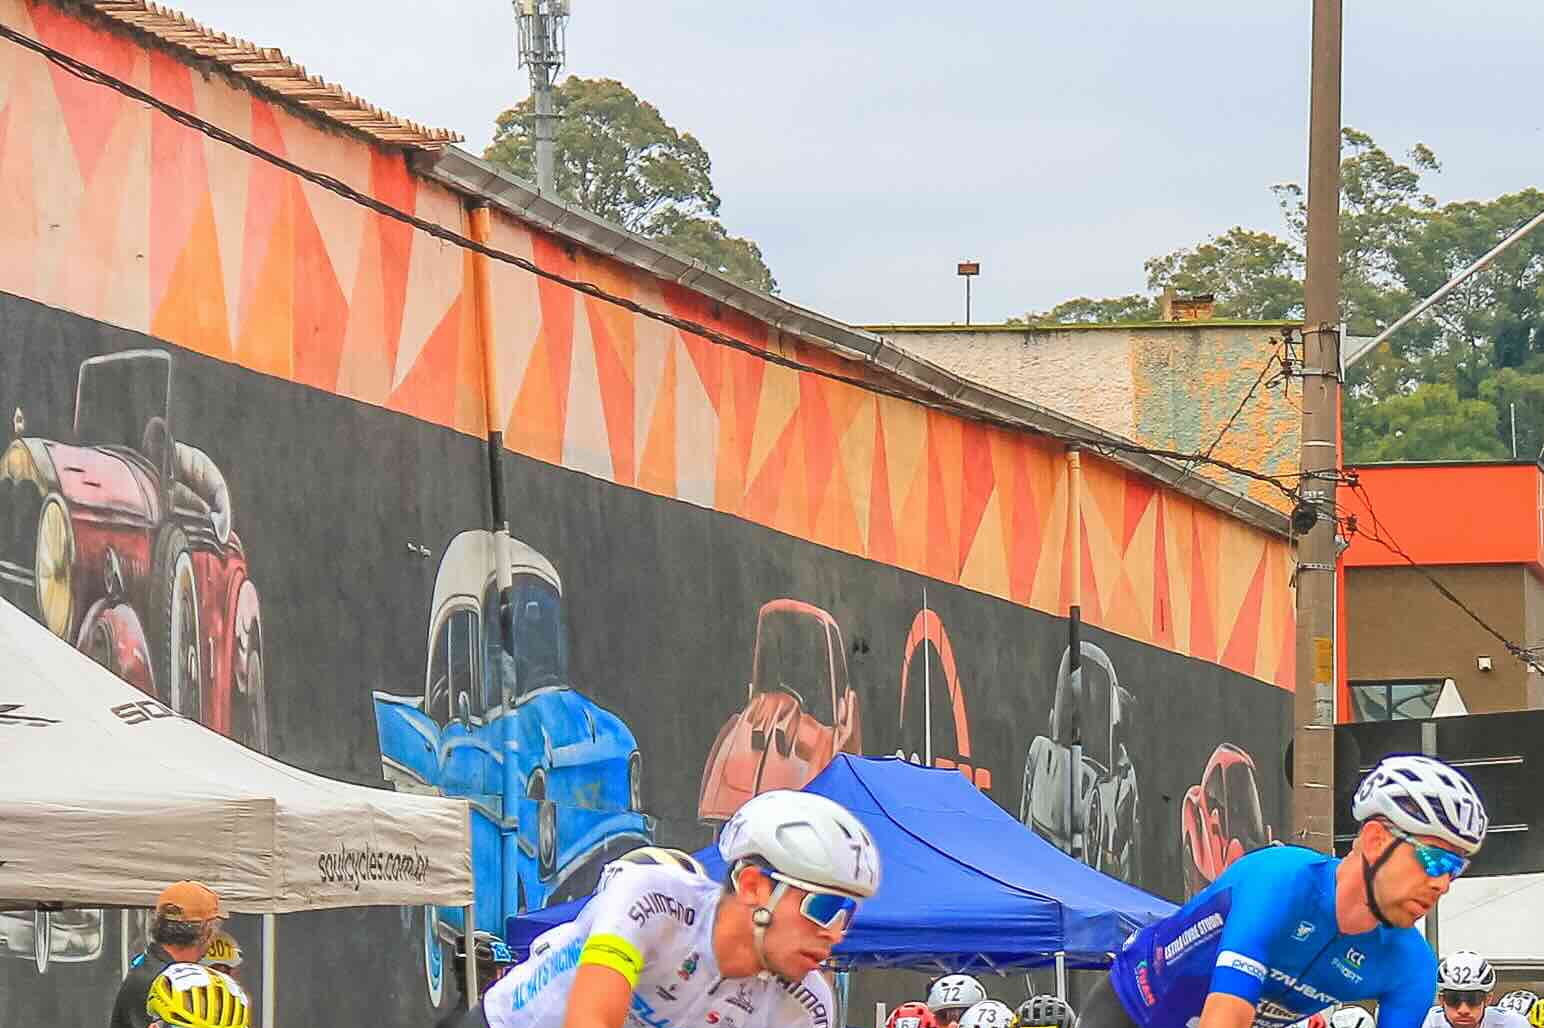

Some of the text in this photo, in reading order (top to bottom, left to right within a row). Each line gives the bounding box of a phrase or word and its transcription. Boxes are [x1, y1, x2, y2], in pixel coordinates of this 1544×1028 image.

[318, 841, 430, 891] soulcycles.com.br
[628, 891, 697, 928] SHIMANO
[1452, 967, 1472, 984] 32
[942, 987, 960, 1002] 72
[978, 1008, 997, 1023] 73
